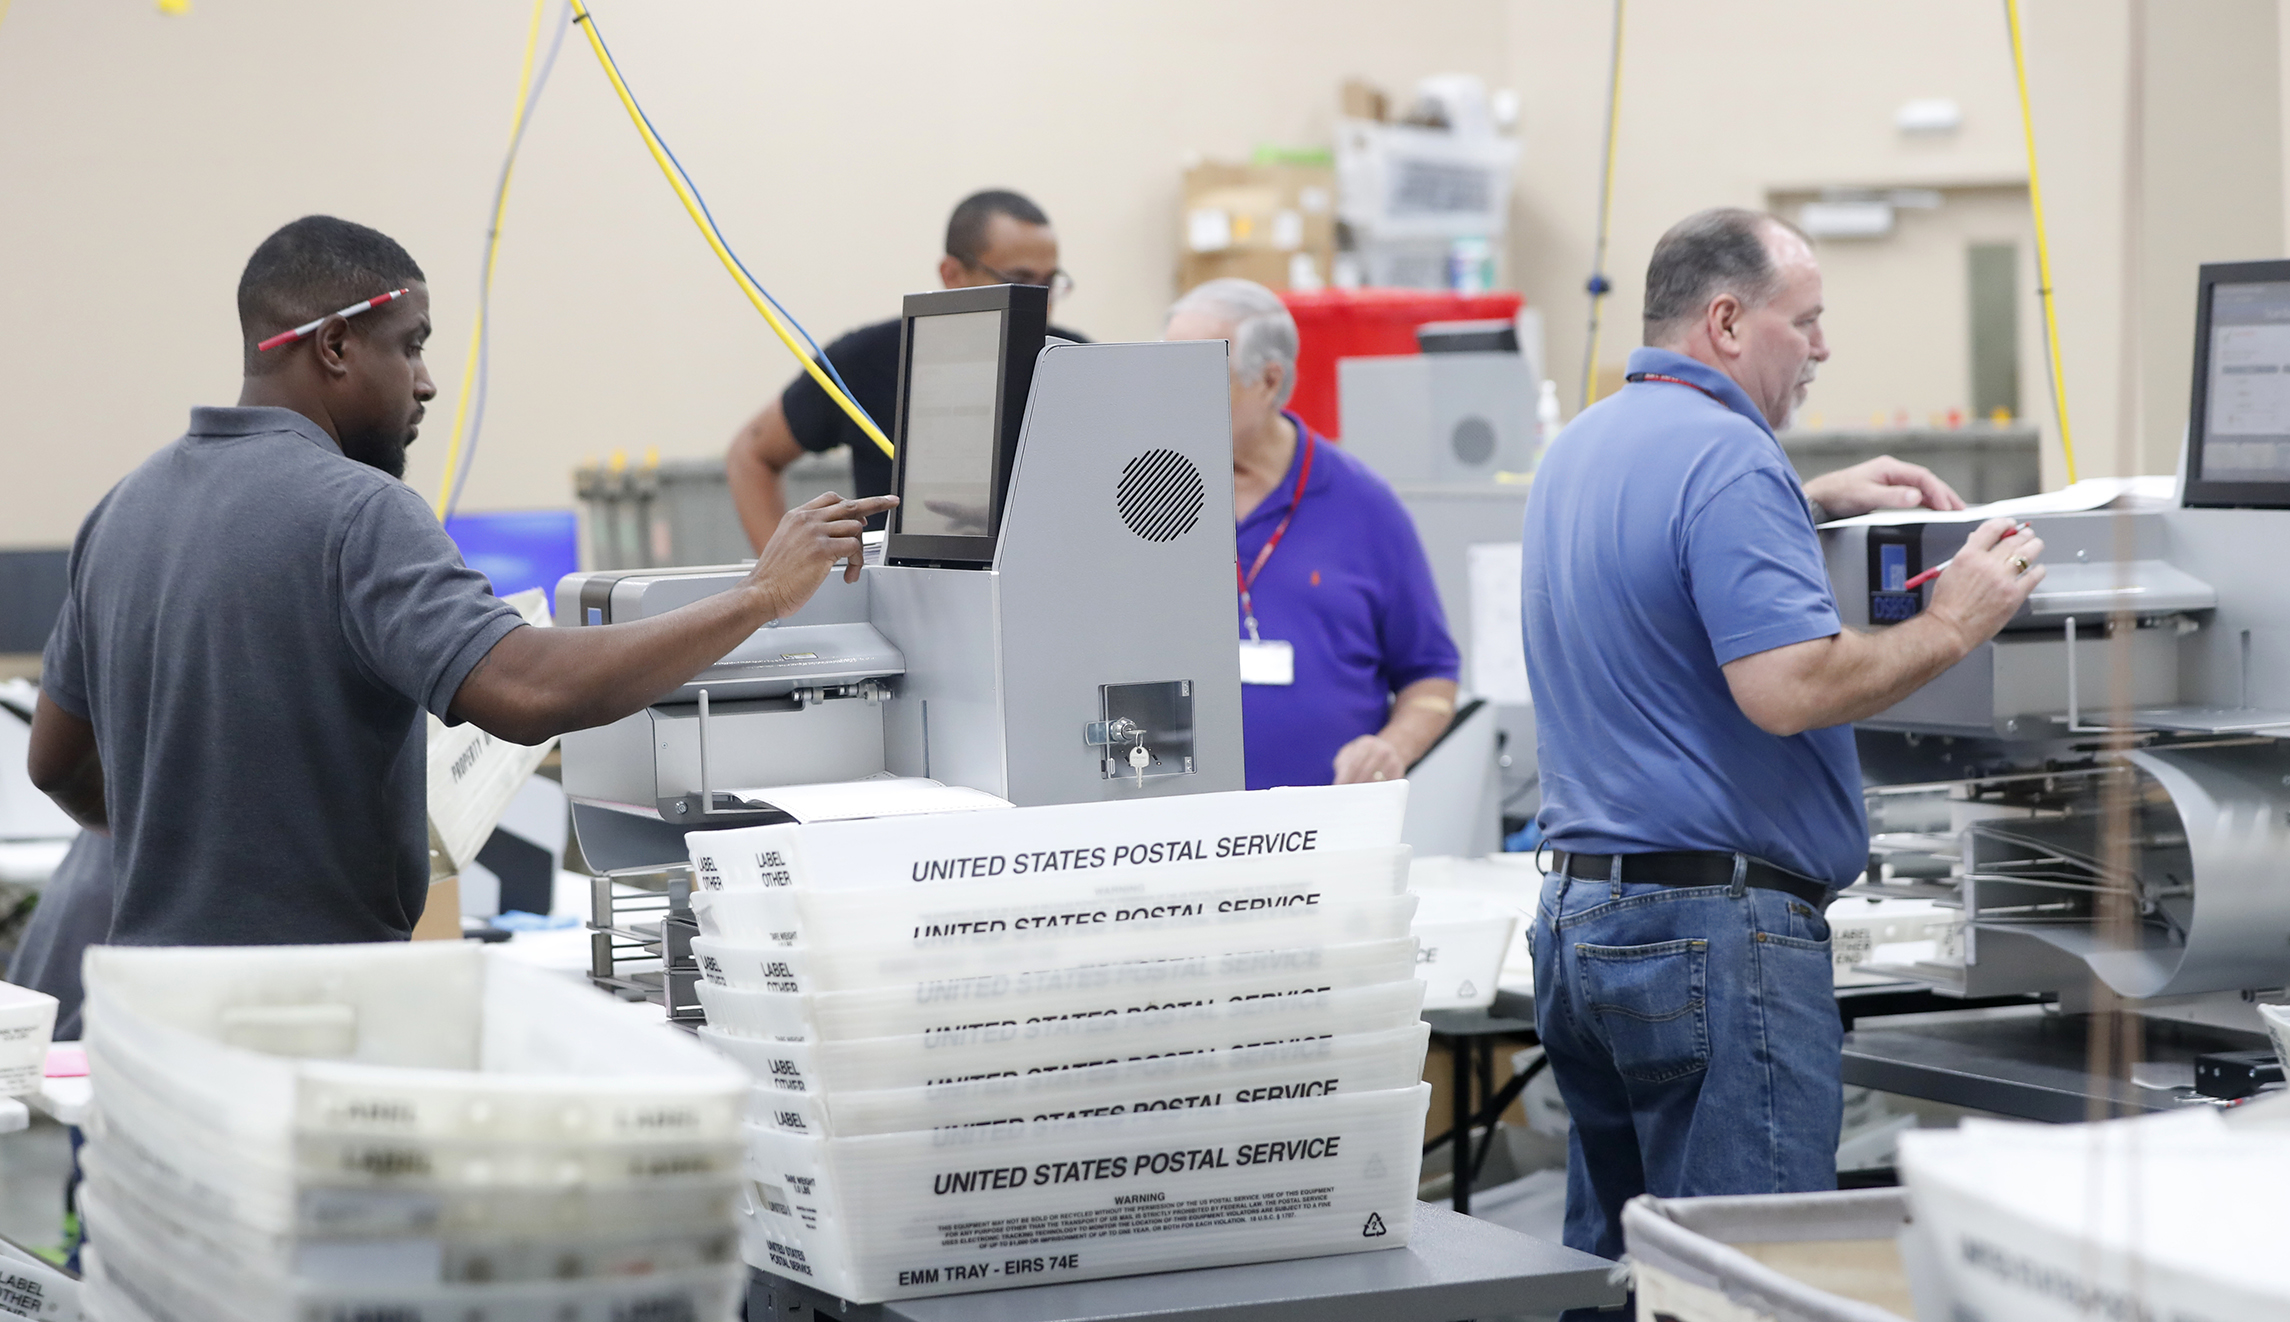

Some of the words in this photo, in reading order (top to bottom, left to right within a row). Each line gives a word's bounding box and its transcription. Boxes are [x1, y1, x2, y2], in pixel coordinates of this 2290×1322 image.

[697, 856, 718, 871] LABEL
[756, 851, 786, 868] LABEL
[911, 856, 1006, 882] UNITED
[1012, 847, 1106, 875] STATES
[1112, 840, 1208, 866] POSTAL
[1215, 829, 1318, 858] SERVICE
[702, 876, 724, 891] OTHER
[761, 870, 792, 888] OTHER
[700, 954, 722, 973] LABEL
[760, 962, 794, 978] LABEL
[767, 1059, 801, 1076] LABEL
[774, 1110, 806, 1128] LABEL
[934, 1166, 1028, 1196] UNITED
[1033, 1156, 1127, 1187] STATES
[1133, 1148, 1229, 1178] POSTAL
[1236, 1136, 1342, 1167] SERVICE
[953, 1220, 989, 1229] EQUIPMENT
[1030, 1214, 1047, 1222] SOLD
[1060, 1210, 1093, 1219] RECYCLED
[1094, 1207, 1122, 1215] WITHOUT
[1137, 1202, 1174, 1211] PERMISSION
[1209, 1196, 1231, 1204] POSTAL
[1300, 1186, 1334, 1195] EQUIPMENT
[1114, 1192, 1166, 1207] WARNING
[974, 1226, 1003, 1235] PURPOSE
[1005, 1224, 1027, 1232] OTHER
[1061, 1217, 1098, 1226] TRANSPORT
[1143, 1209, 1171, 1218] STRICTLY
[1172, 1206, 1209, 1215] PROHIBITED
[1220, 1202, 1247, 1210] FEDERAL
[1278, 1197, 1300, 1205] POSTAL
[1302, 1194, 1327, 1202] SERVICE
[941, 1238, 958, 1246] USES
[959, 1234, 999, 1244] ELECTRONIC
[1001, 1231, 1033, 1240] TRACKING
[1035, 1226, 1077, 1236] TECHNOLOGY
[1088, 1222, 1116, 1231] MONITOR
[1131, 1218, 1162, 1226] LOCATION
[1226, 1208, 1259, 1217] VIOLATORS
[1274, 1204, 1301, 1212] SUBJECT
[1372, 1221, 1377, 1230] 2
[766, 1240, 785, 1255] UNITED
[785, 1246, 806, 1261] STATES
[769, 1252, 790, 1269] POSTAL
[789, 1259, 813, 1276] SERVICE
[899, 1269, 939, 1287] EMM
[944, 1264, 990, 1283] TRAY
[1005, 1258, 1045, 1276] EIRS
[1049, 1254, 1080, 1271] 74E
[0, 1271, 44, 1297] LABEL
